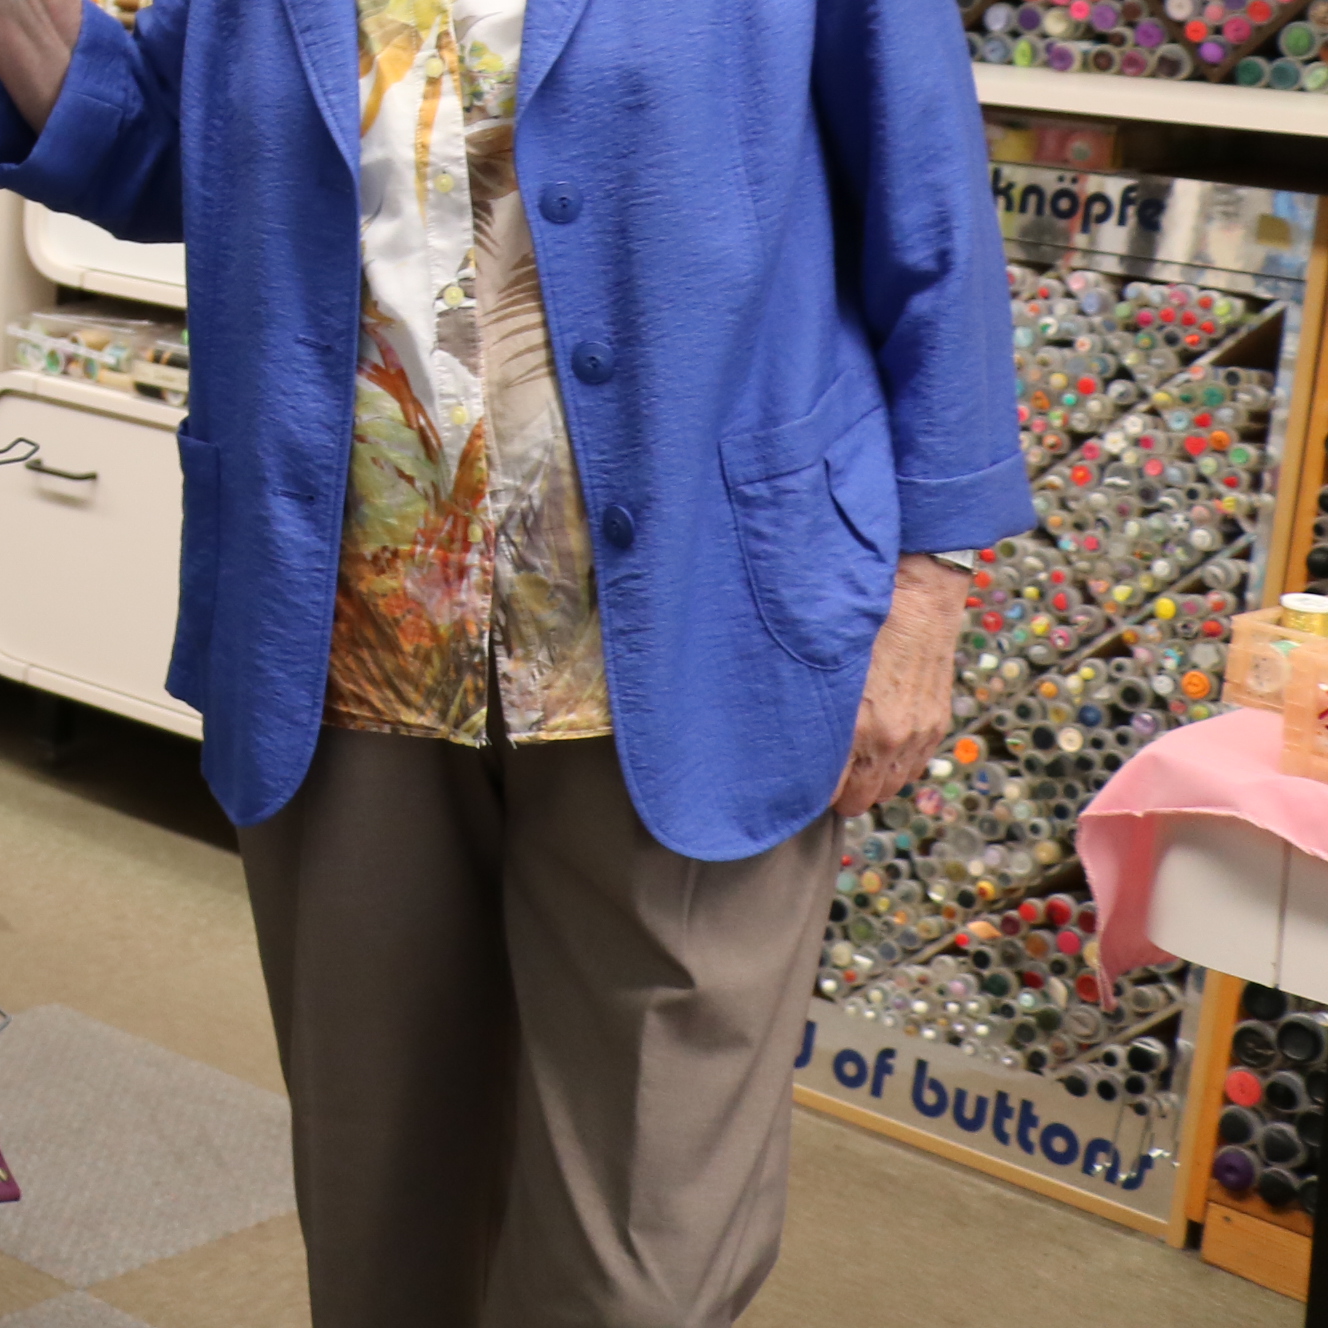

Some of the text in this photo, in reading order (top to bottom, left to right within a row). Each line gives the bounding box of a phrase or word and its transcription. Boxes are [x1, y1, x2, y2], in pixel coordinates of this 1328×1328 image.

[992, 167, 1165, 234] knöpfe
[832, 1048, 1155, 1190] of buttons
